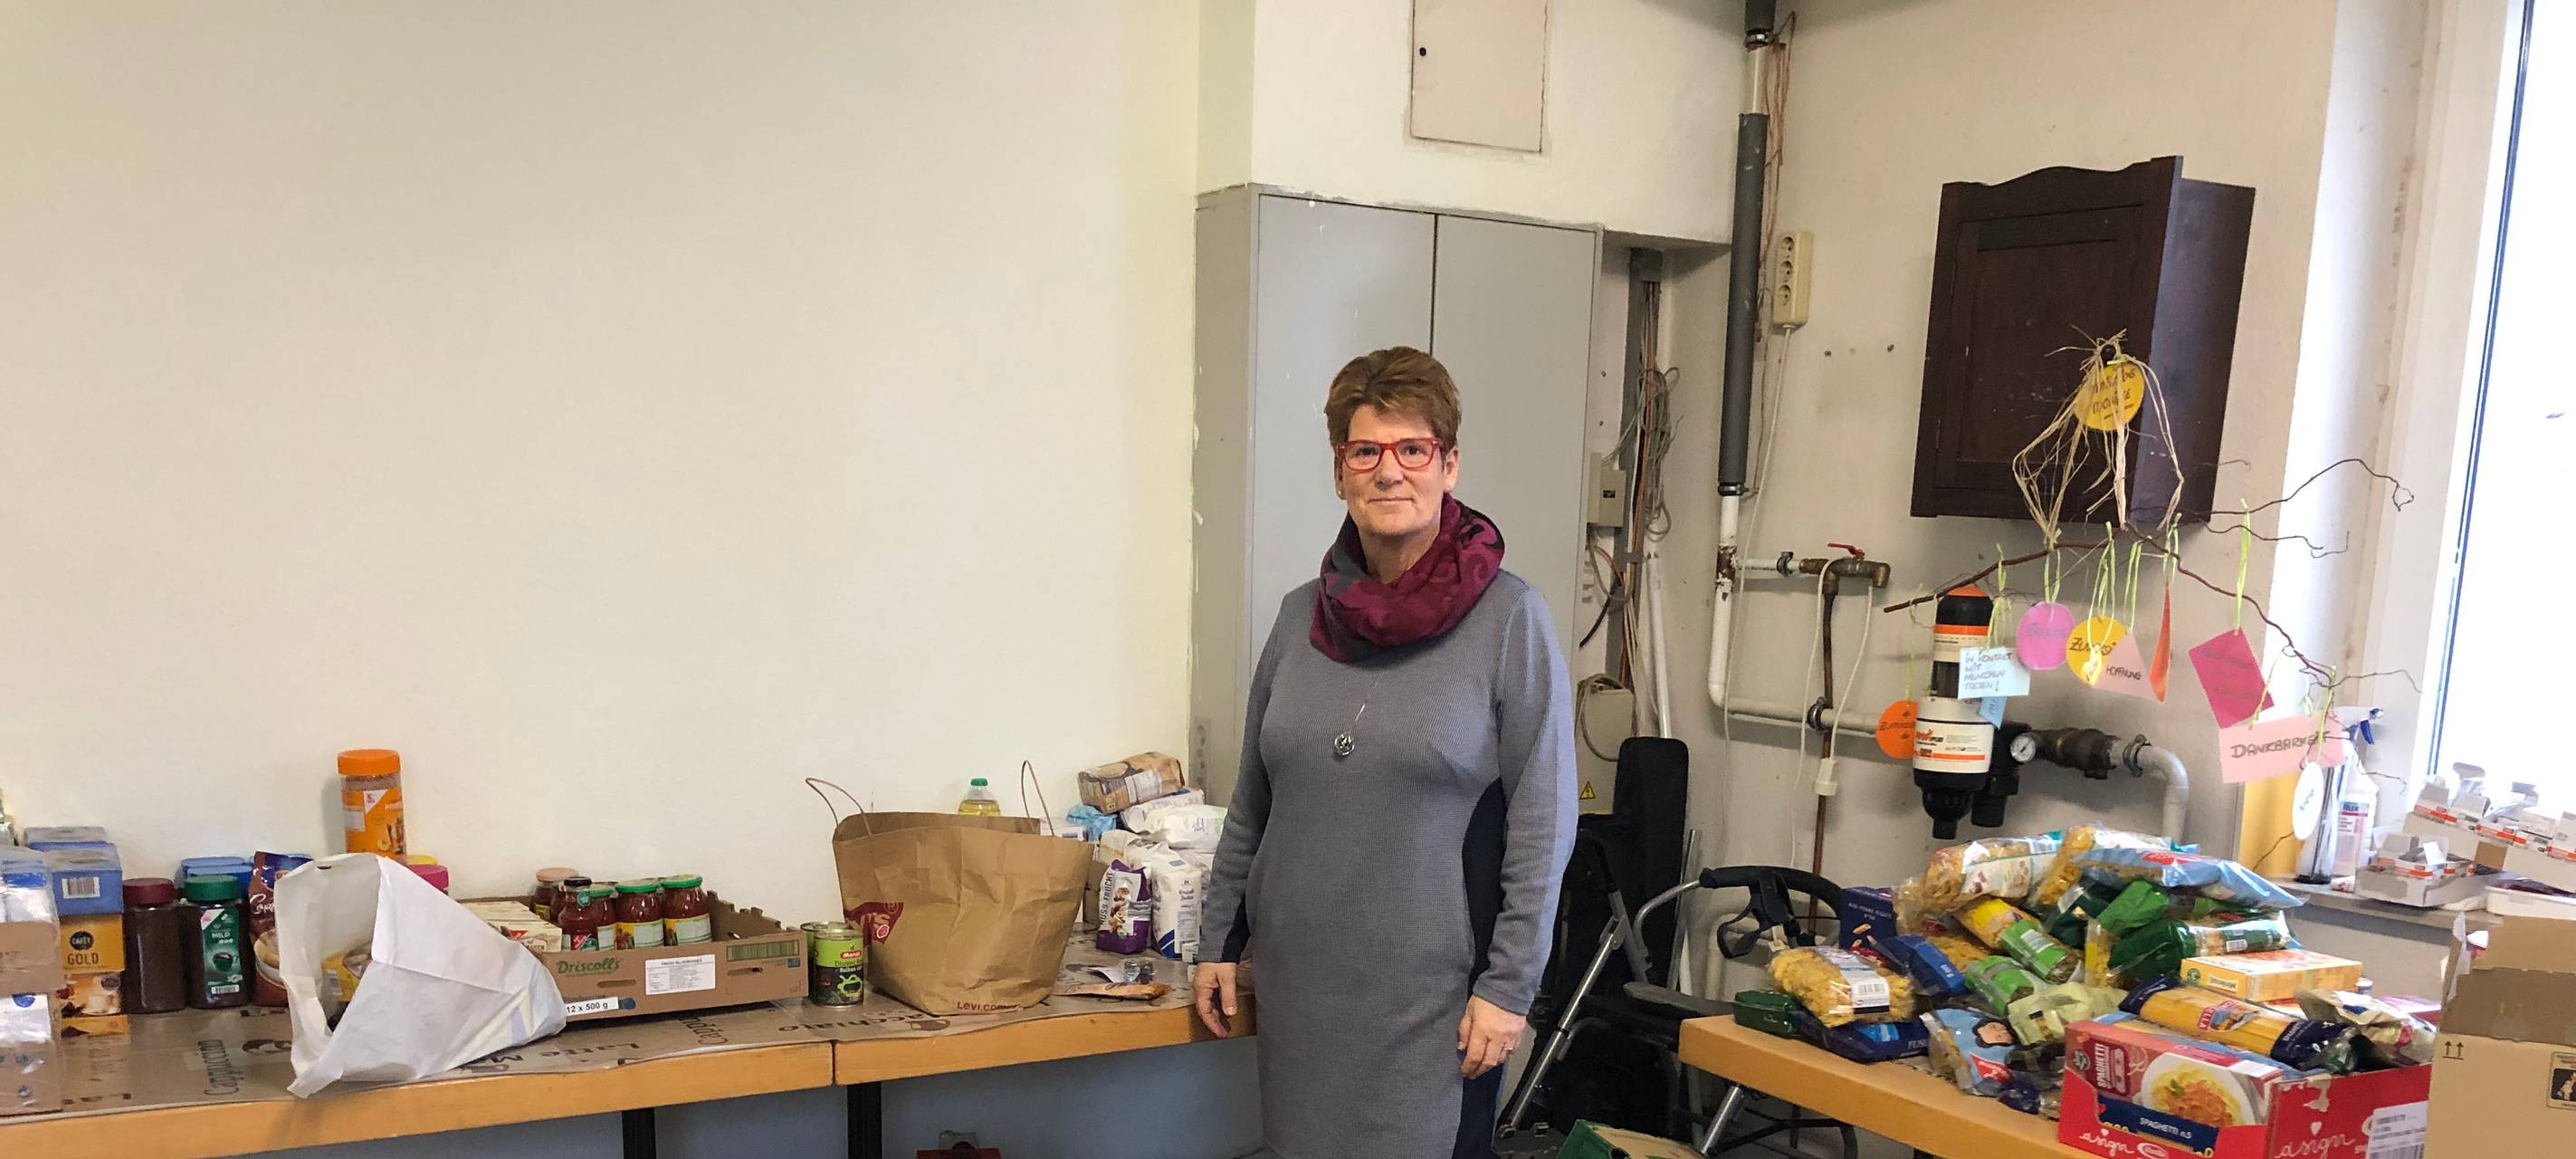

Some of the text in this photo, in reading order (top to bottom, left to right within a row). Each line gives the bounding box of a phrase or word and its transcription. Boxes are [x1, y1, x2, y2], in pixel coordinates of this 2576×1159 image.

[211, 931, 231, 939] MILD
[67, 952, 99, 965] GOLD
[566, 1005, 576, 1013] 12
[586, 1001, 600, 1010] 500
[2094, 1042, 2113, 1089] SPAGHETTI
[2140, 1117, 2179, 1135] SPAGHETTI
